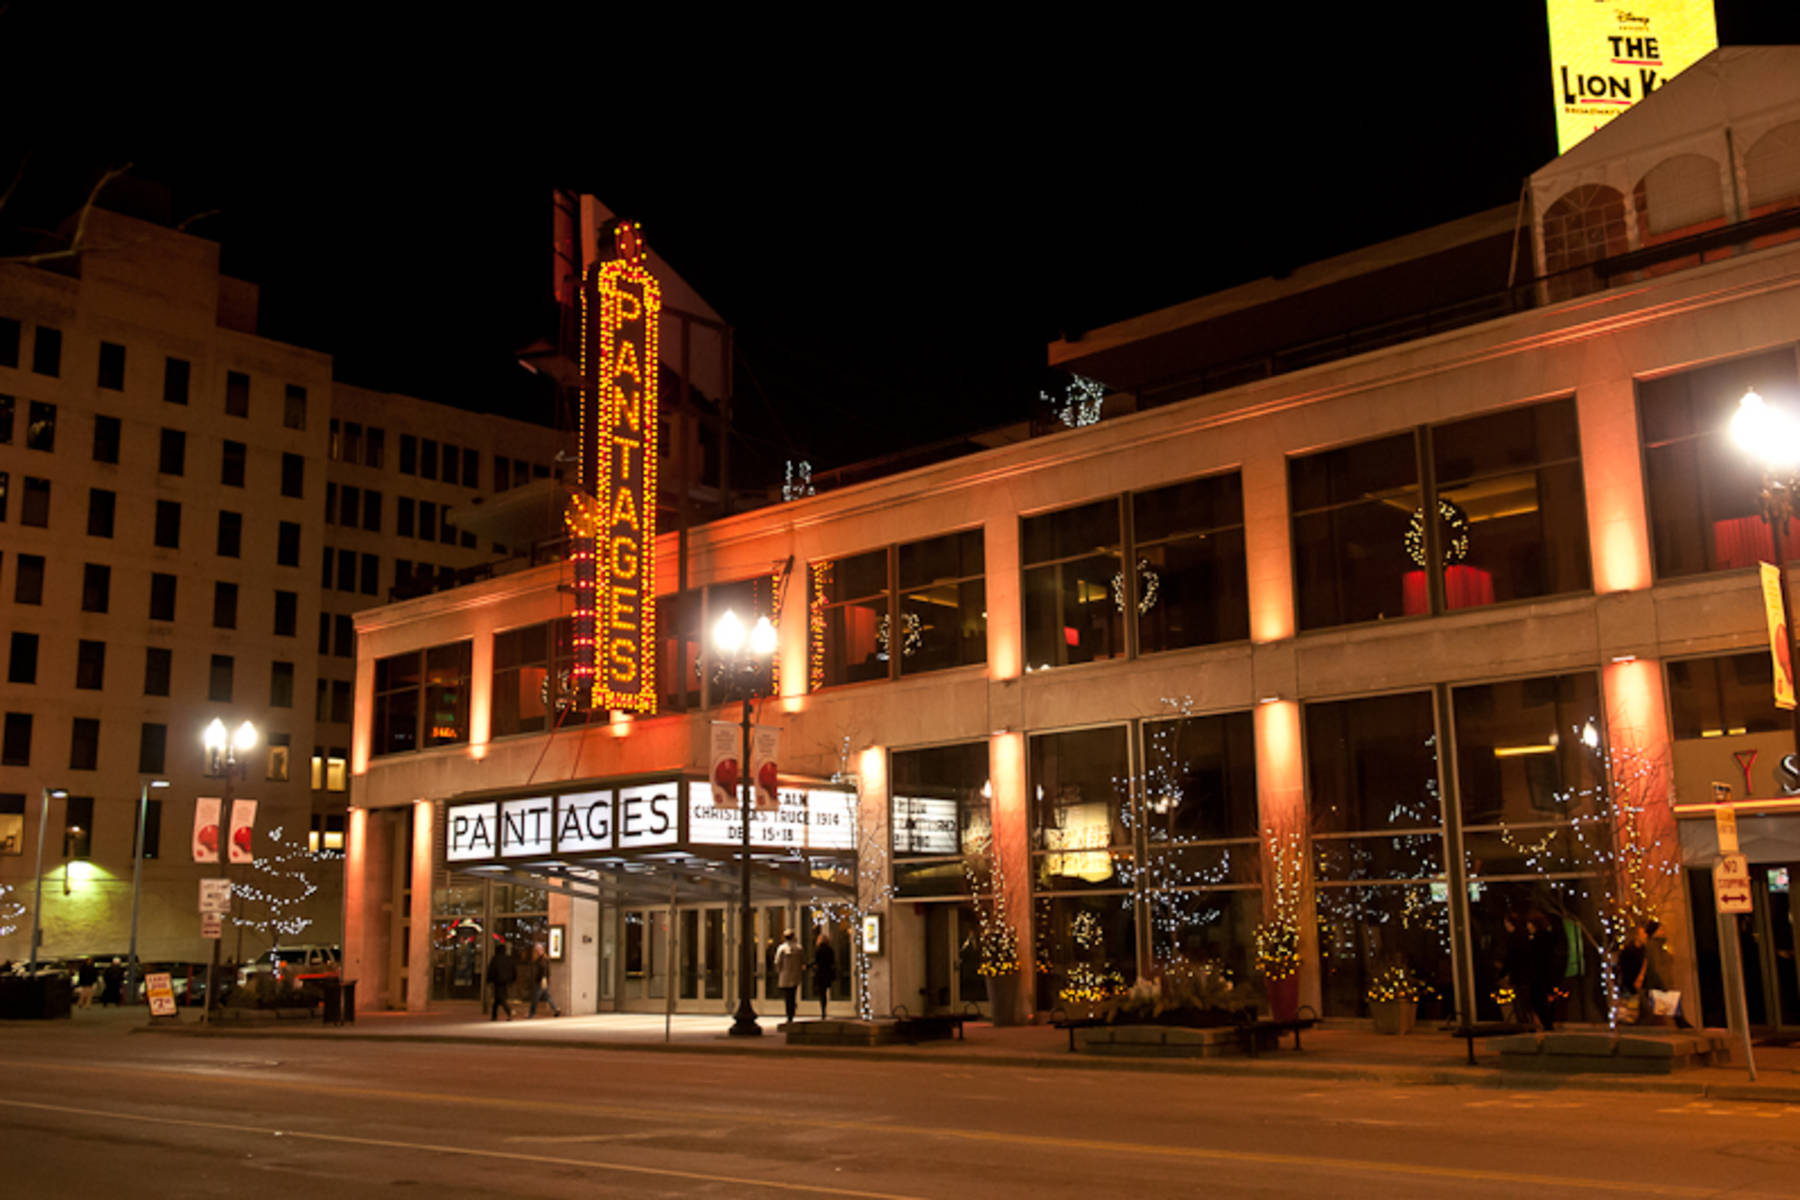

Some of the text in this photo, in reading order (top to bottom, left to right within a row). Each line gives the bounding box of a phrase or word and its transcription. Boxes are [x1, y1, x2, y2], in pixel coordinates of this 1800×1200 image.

[1608, 36, 1660, 59] THE
[609, 289, 642, 684] PANTAGES
[453, 794, 670, 851] PANTAGES
